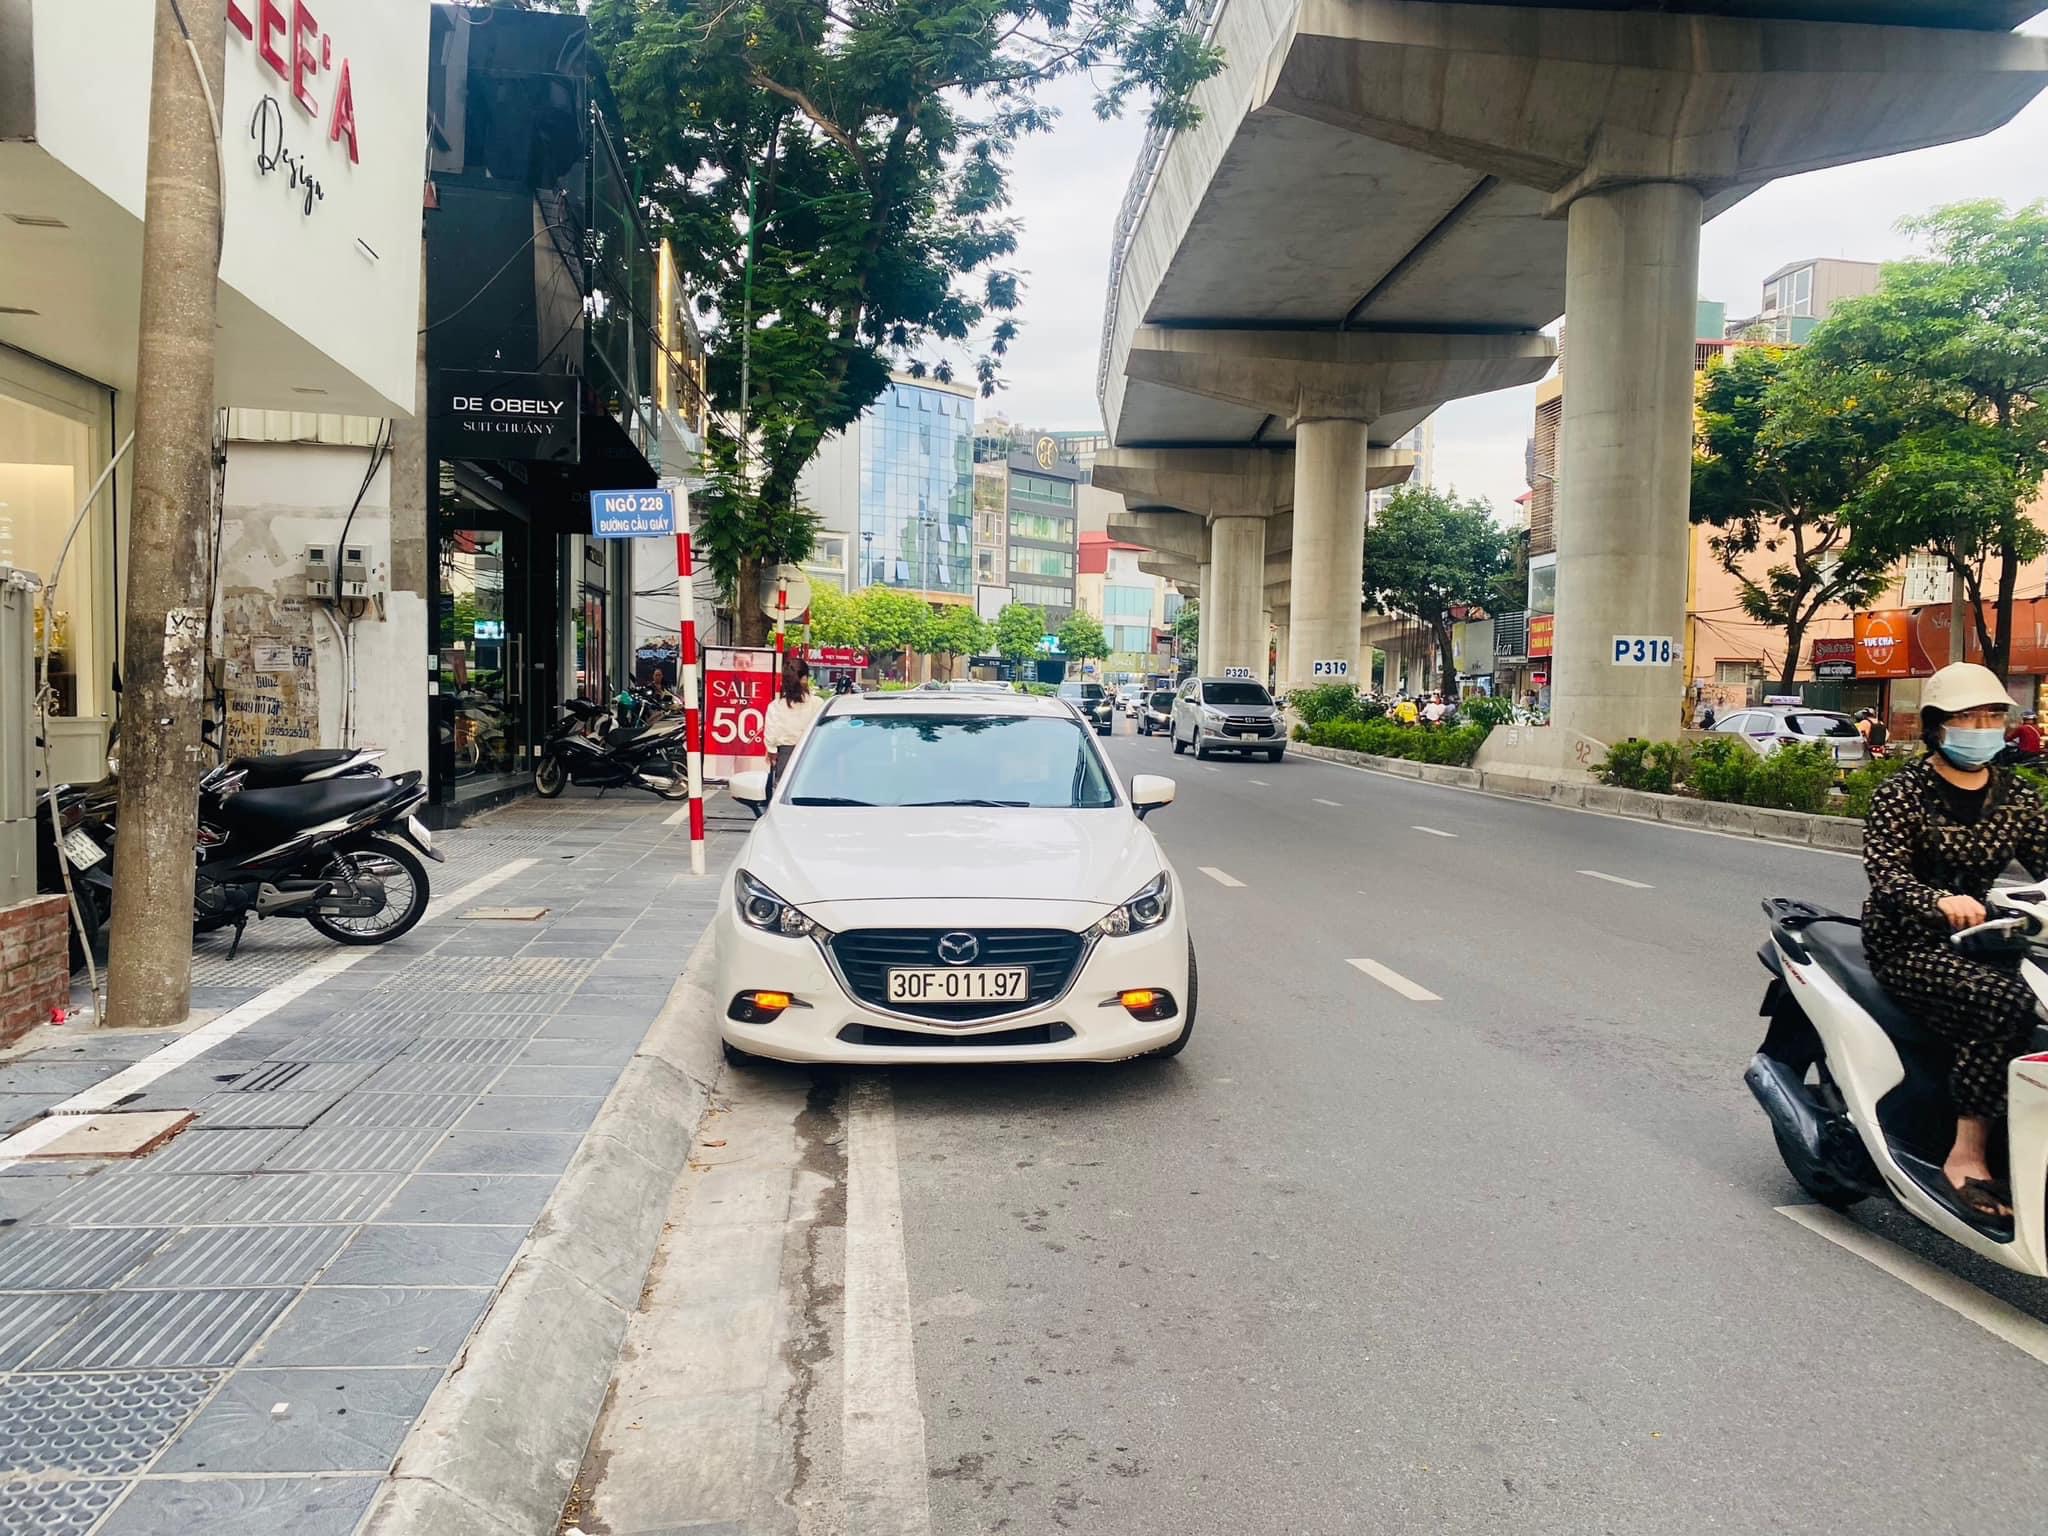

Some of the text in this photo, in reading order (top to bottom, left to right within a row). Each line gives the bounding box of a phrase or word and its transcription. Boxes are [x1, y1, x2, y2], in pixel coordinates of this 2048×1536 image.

[251, 94, 324, 216] Design
[453, 396, 483, 411] DE
[463, 421, 493, 432] SUIT
[605, 494, 664, 513] NGÕ 228
[1615, 640, 1670, 662] P318
[1225, 668, 1249, 678] P320
[1314, 662, 1347, 675] P319
[712, 680, 762, 699] SALE
[711, 706, 764, 744] 50%
[893, 972, 1022, 998] 30F-011.97
